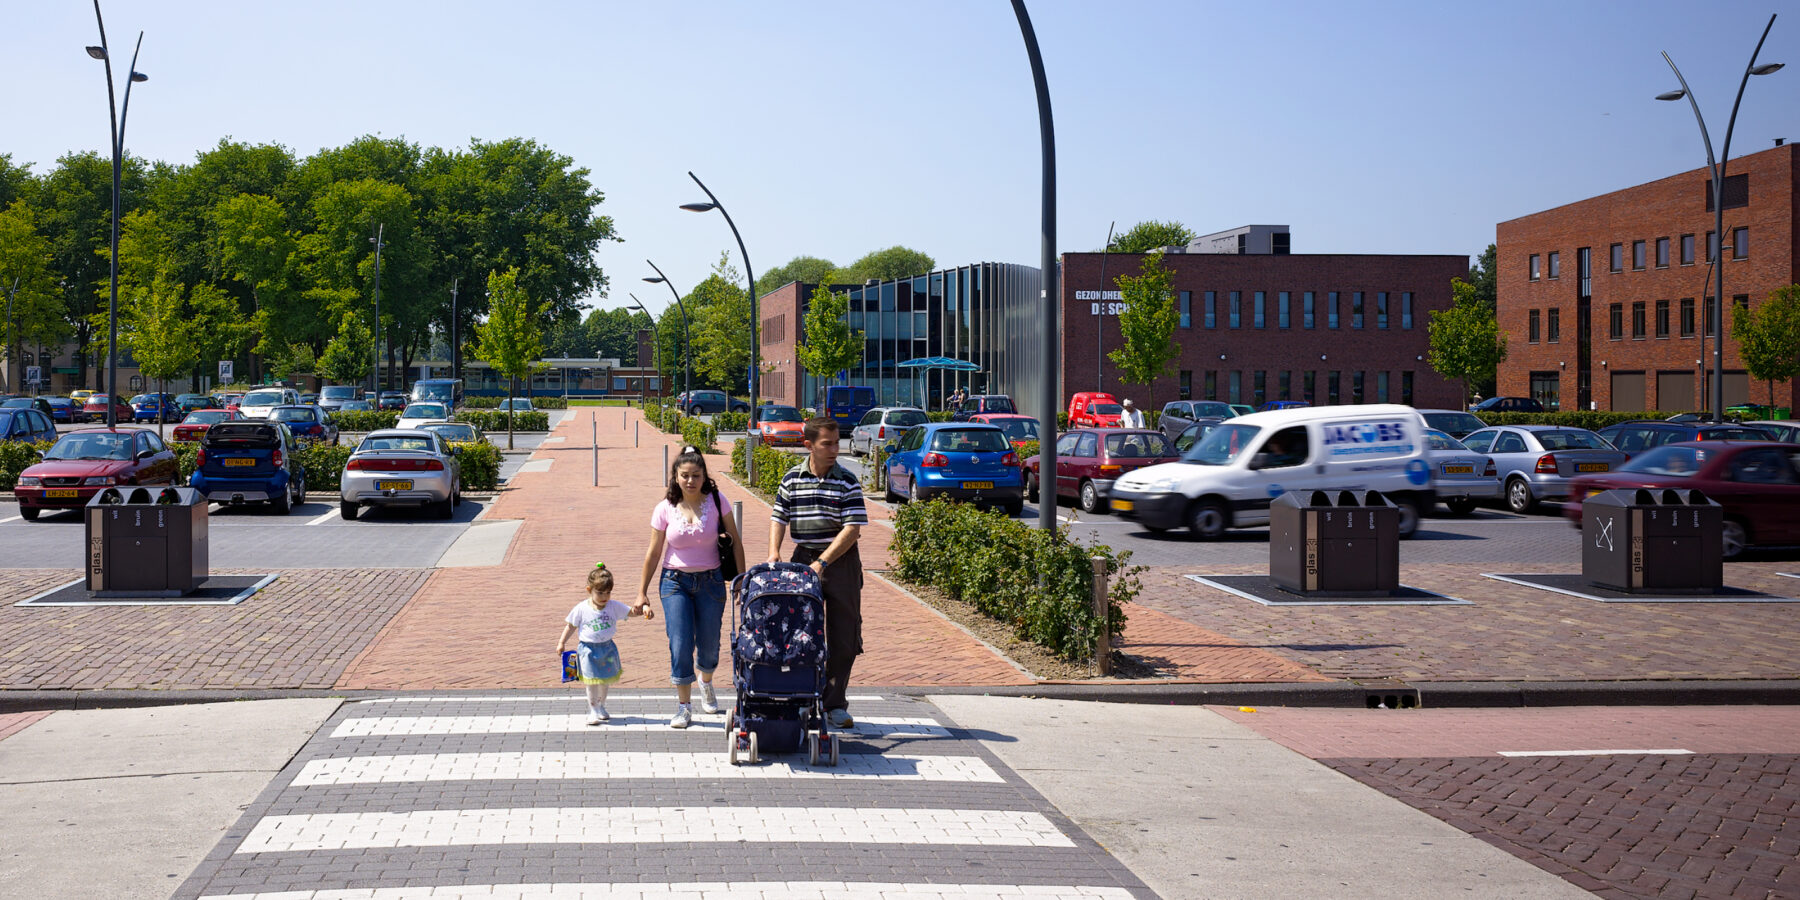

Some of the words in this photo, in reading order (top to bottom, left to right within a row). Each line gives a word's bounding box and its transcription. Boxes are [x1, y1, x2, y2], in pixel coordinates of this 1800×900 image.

[92, 552, 103, 575] glas
[1306, 553, 1317, 575] glas
[1633, 551, 1643, 573] glas
